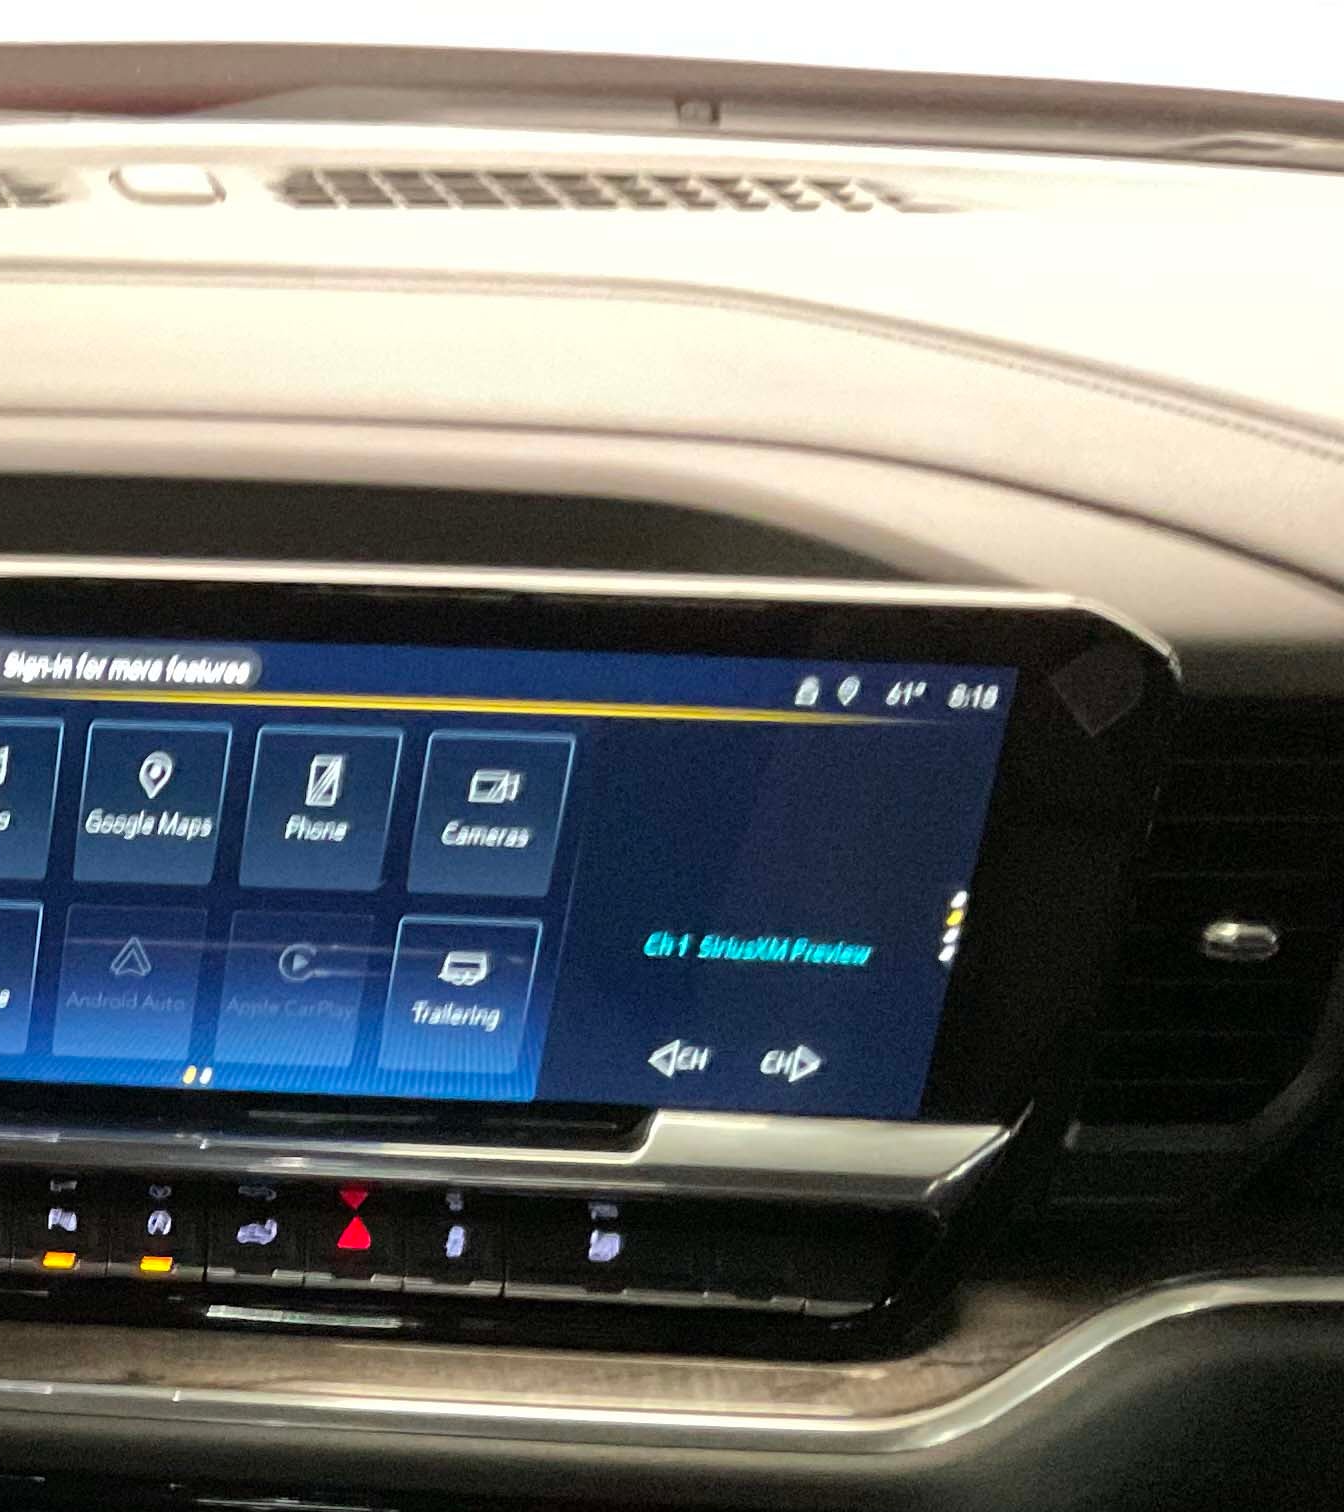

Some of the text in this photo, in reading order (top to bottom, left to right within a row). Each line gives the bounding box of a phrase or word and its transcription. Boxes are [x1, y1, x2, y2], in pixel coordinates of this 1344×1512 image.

[76, 652, 108, 680] for
[109, 657, 163, 682] more
[165, 655, 251, 685] features
[85, 809, 213, 841] Google Maps
[284, 815, 350, 843] Phone
[440, 821, 531, 850] Cameras
[643, 930, 675, 957] Ch
[788, 938, 873, 967] Preview
[411, 1000, 500, 1033] Trailering
